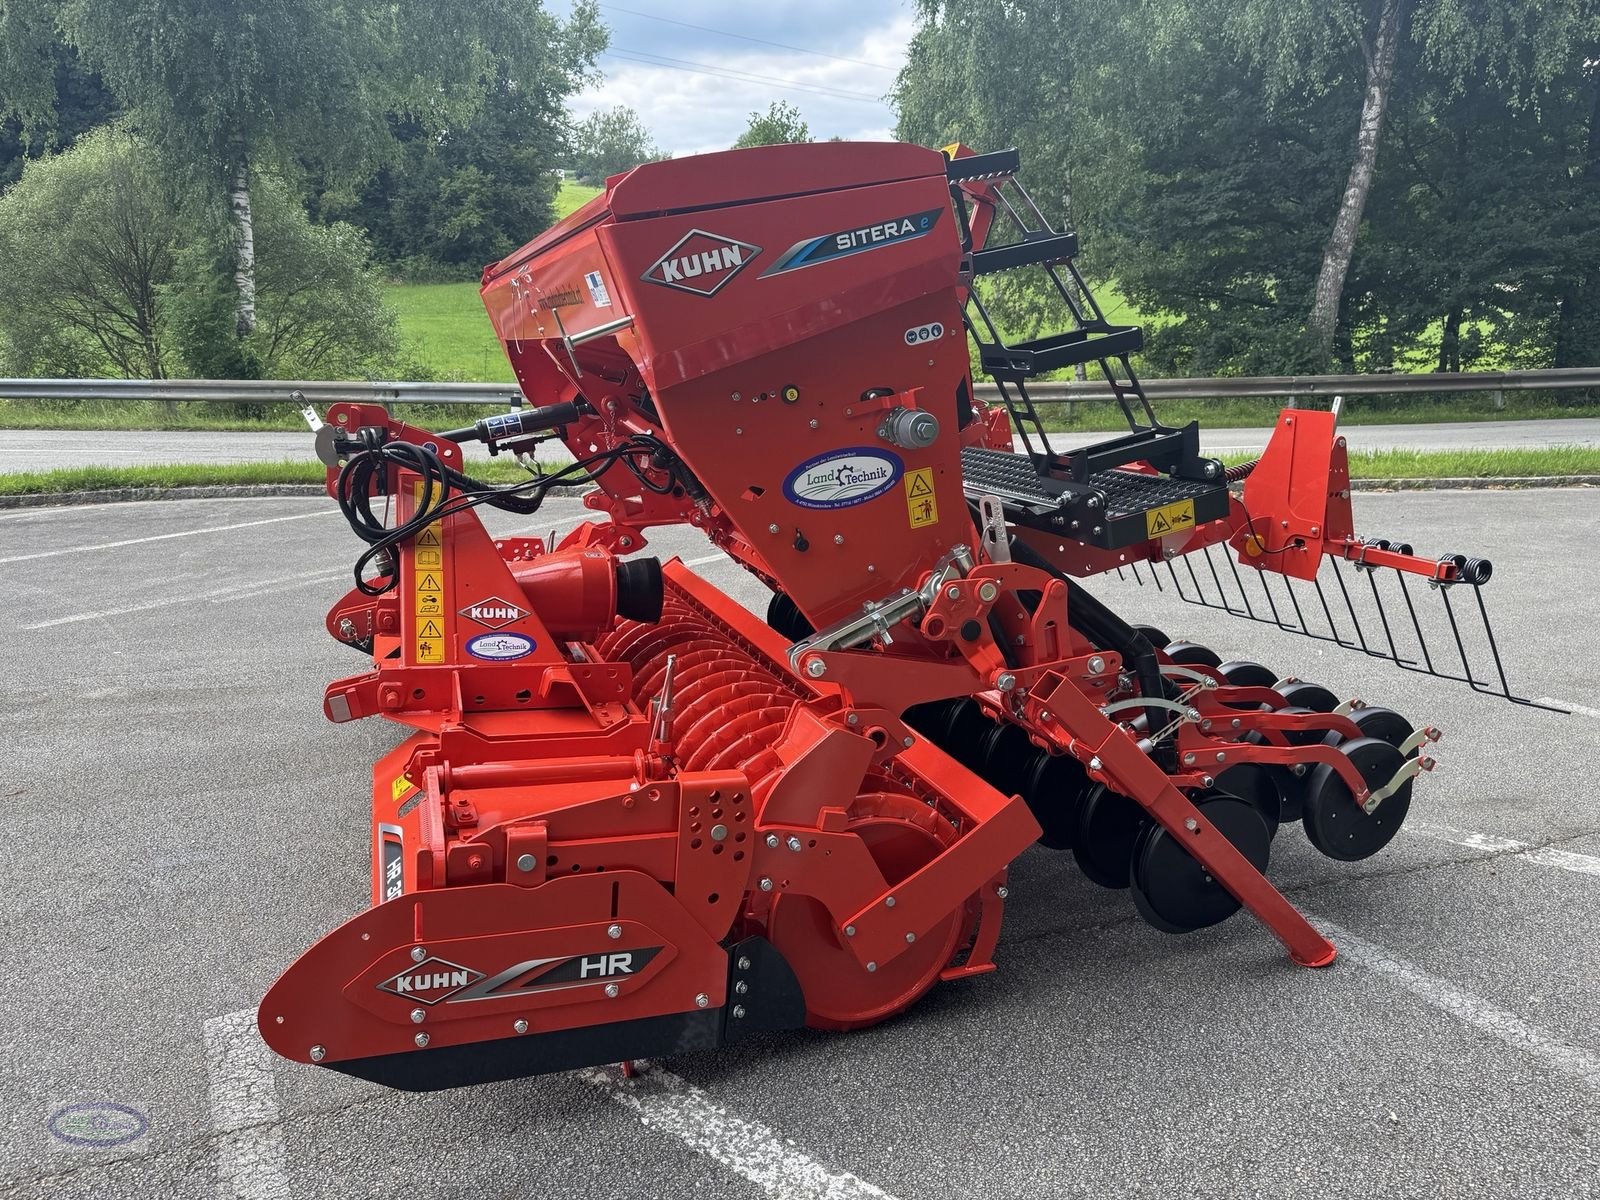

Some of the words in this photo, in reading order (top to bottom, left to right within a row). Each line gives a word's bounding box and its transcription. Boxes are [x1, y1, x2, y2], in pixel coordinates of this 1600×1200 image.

[836, 218, 916, 250] SITERA
[920, 215, 930, 229] e
[660, 244, 743, 283] KUHN
[807, 470, 835, 486] Land
[845, 467, 887, 485] Technik
[471, 607, 519, 619] KUHN
[580, 952, 633, 978] HR
[397, 970, 468, 993] KUHN
